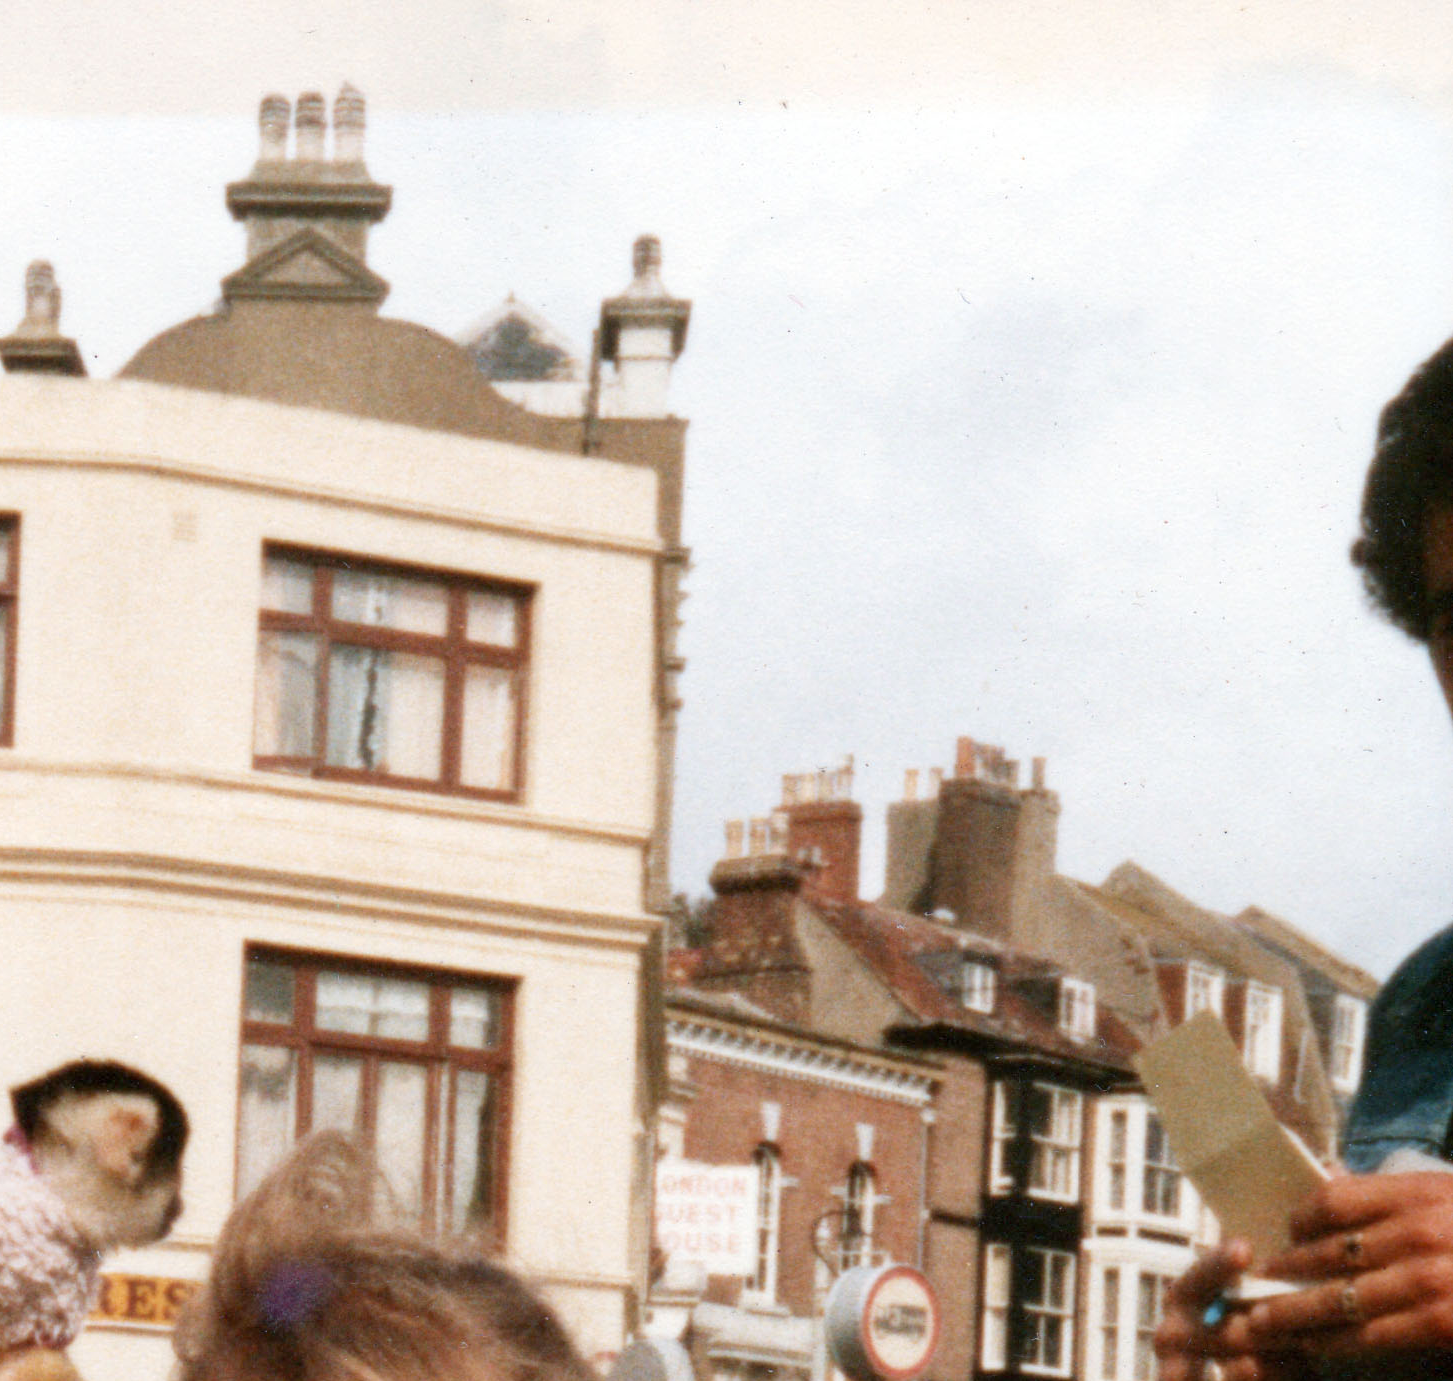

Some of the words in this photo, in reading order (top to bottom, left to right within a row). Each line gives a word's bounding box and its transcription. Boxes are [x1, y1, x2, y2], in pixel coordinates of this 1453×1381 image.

[660, 1174, 748, 1198] ONDON
[659, 1202, 744, 1224] UEST
[660, 1230, 742, 1254] OUSE
